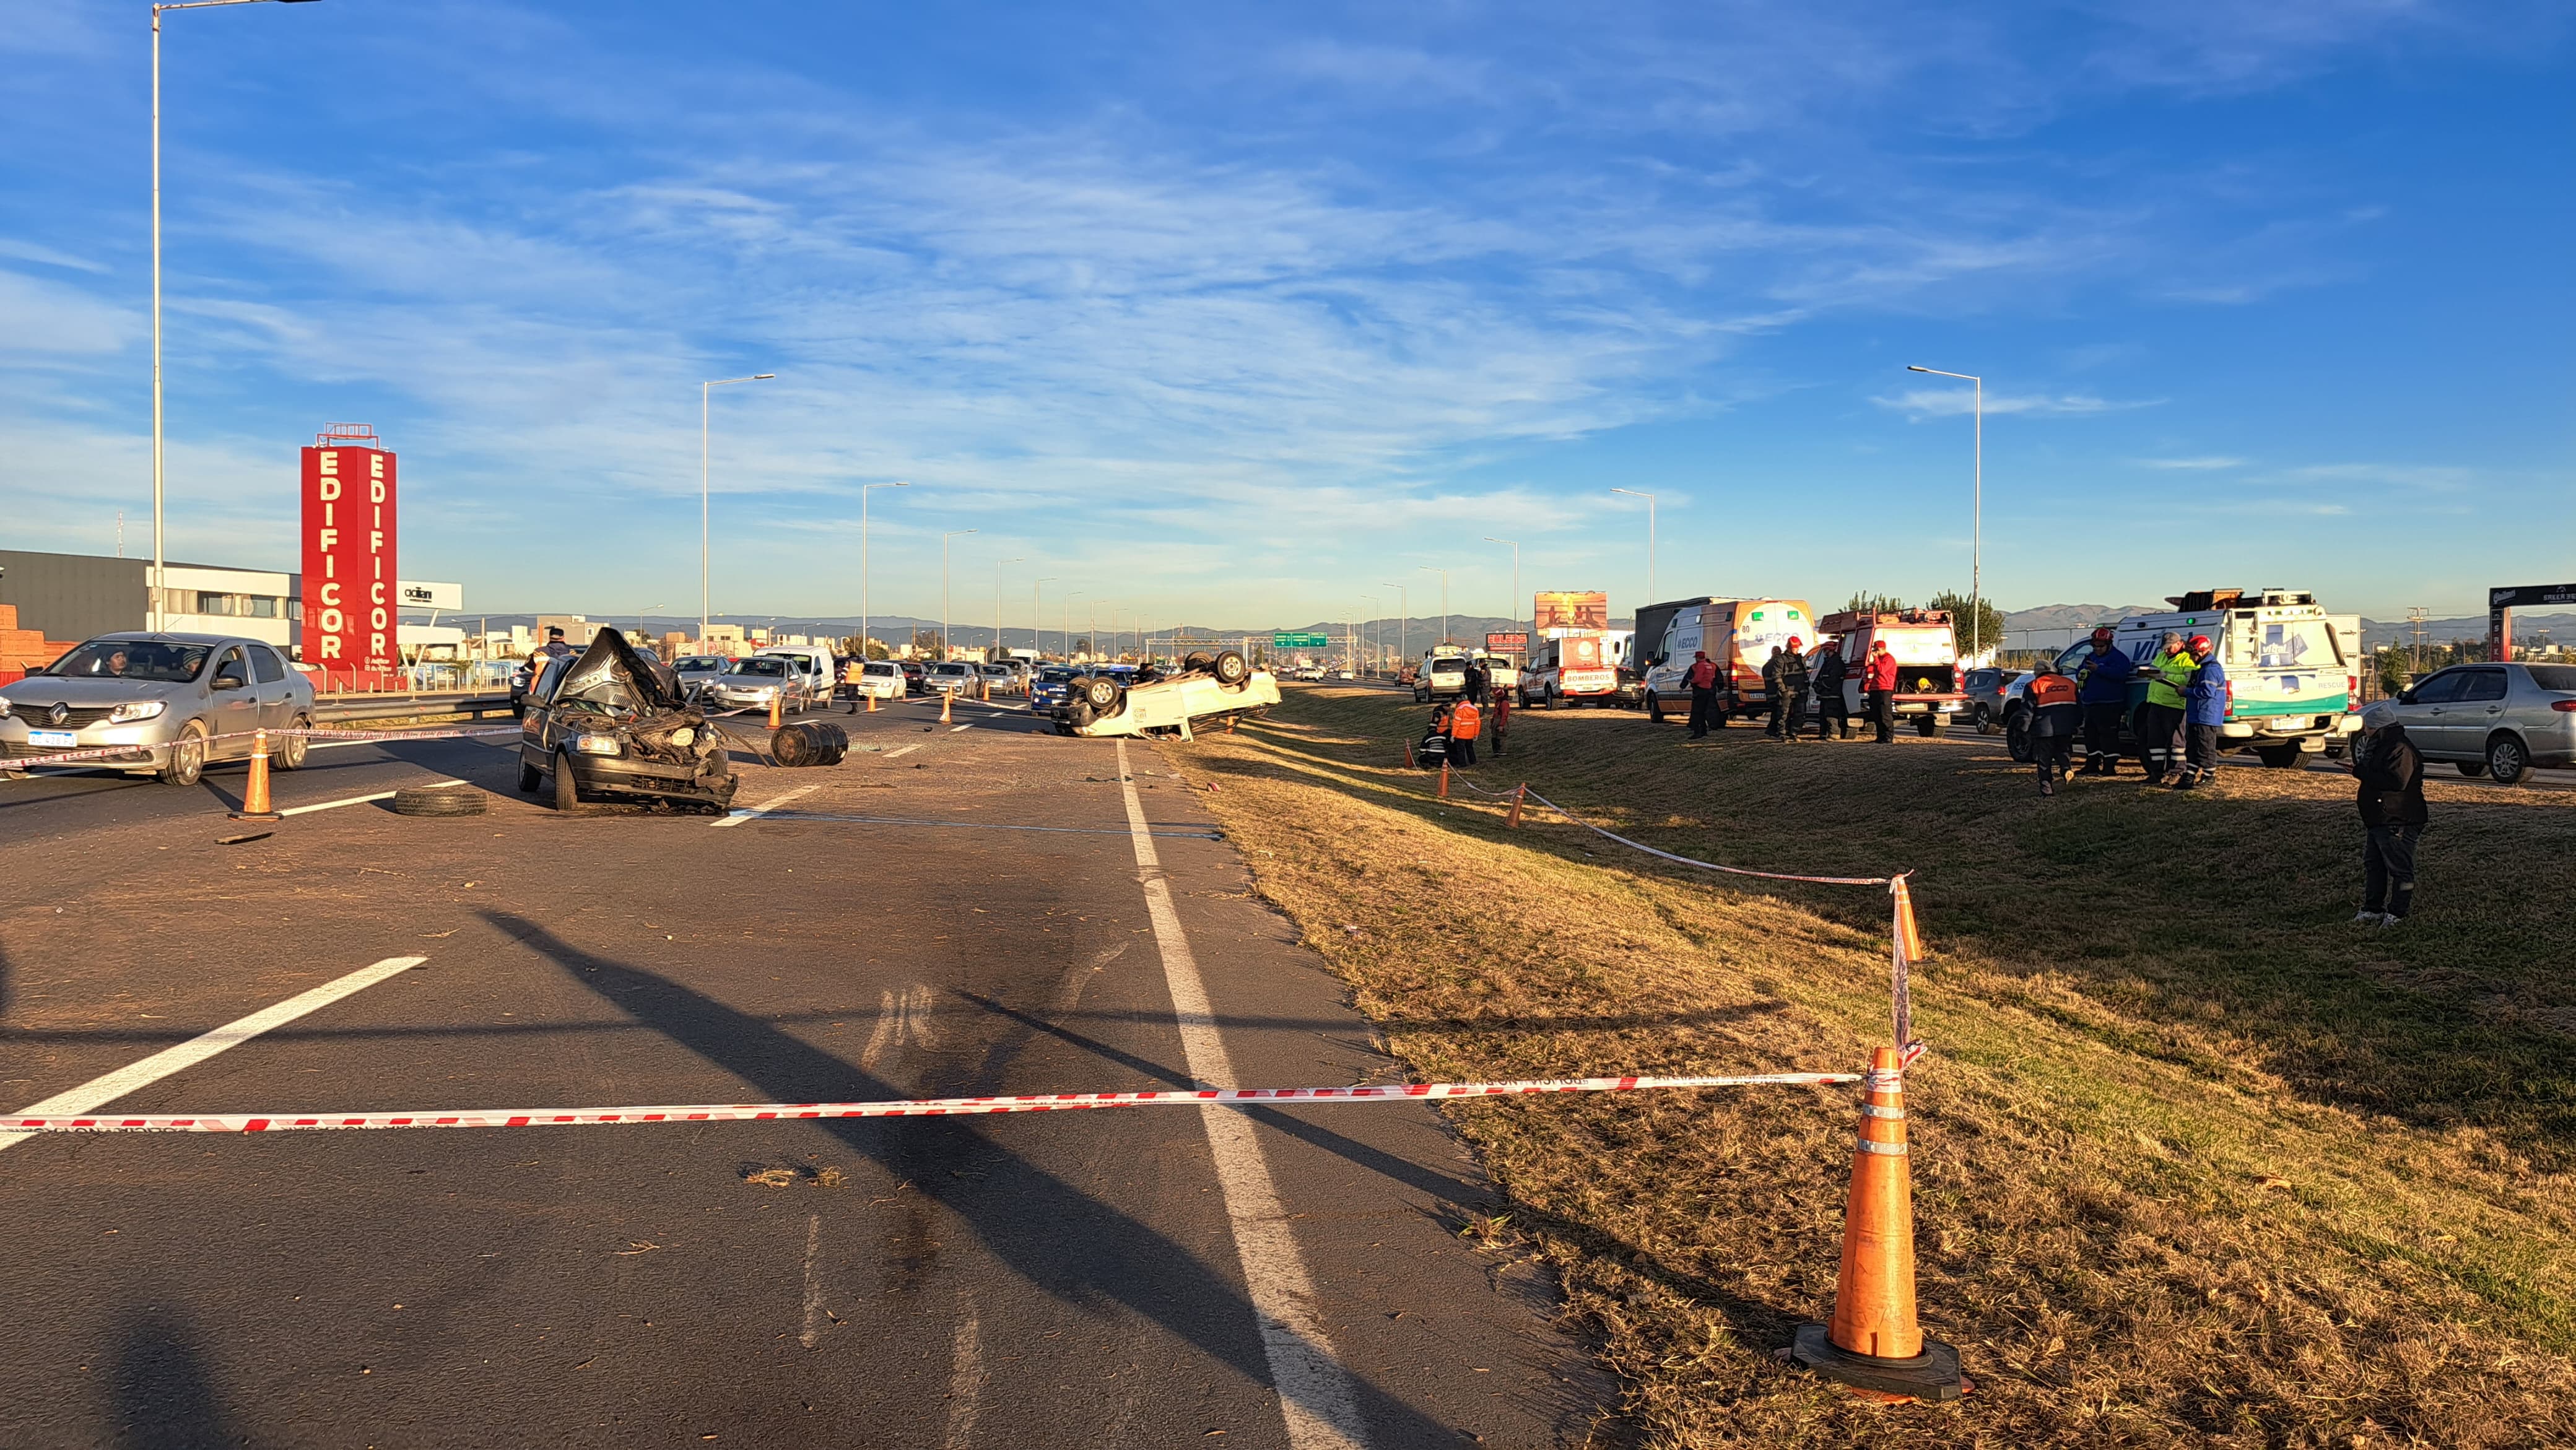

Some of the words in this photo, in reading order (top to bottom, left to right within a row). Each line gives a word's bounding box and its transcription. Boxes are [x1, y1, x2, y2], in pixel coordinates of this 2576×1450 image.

[320, 451, 342, 659] EDIFICOR
[370, 454, 387, 656] EDIFICOR
[1681, 636, 1698, 649] ECCO
[2263, 643, 2287, 653] vital
[1567, 674, 1610, 682] BOMBEROS
[2045, 684, 2069, 693] ECCO
[64, 737, 74, 745] FJ
